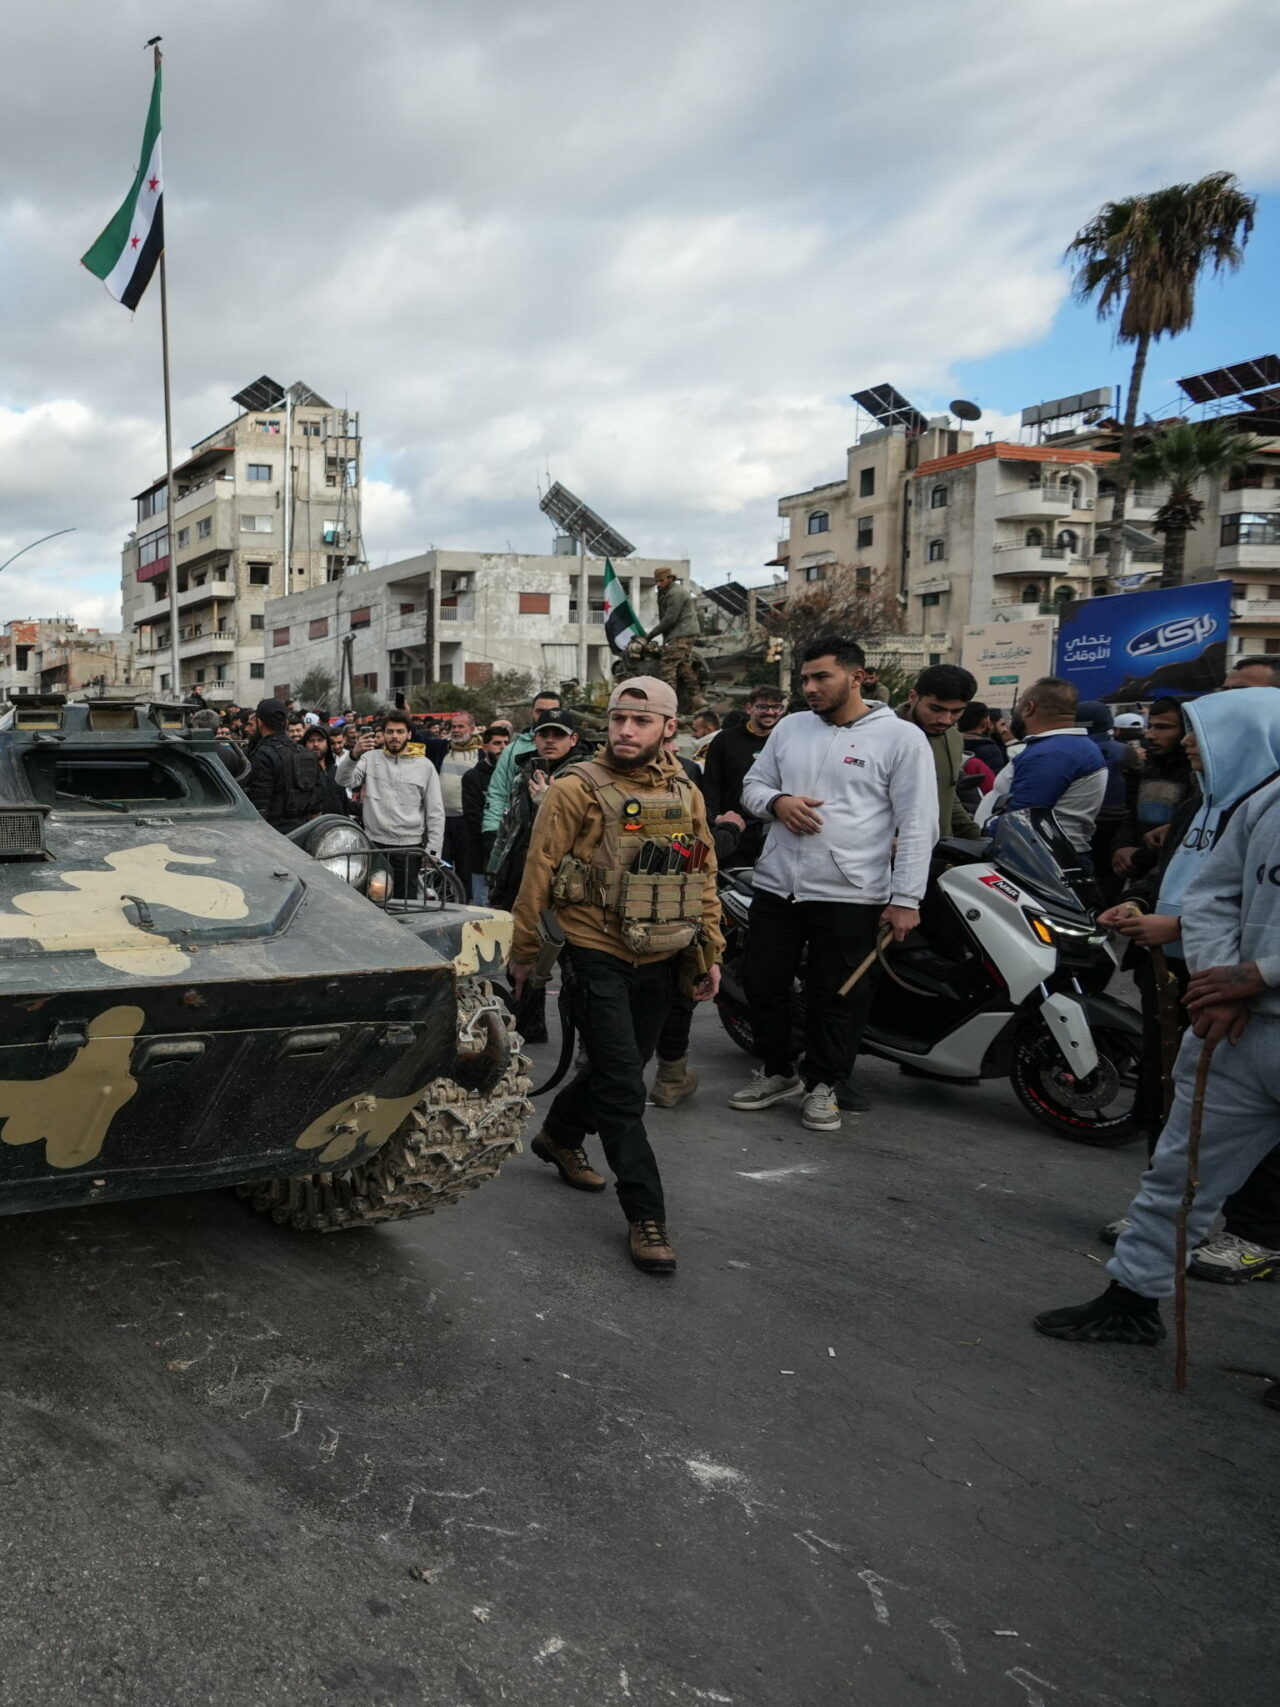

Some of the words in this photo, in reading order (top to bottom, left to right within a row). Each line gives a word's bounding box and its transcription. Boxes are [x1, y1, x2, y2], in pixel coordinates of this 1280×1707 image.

[1065, 634, 1112, 649] بتحلي
[1130, 613, 1211, 657] بركات
[1063, 647, 1111, 662] الأوقات
